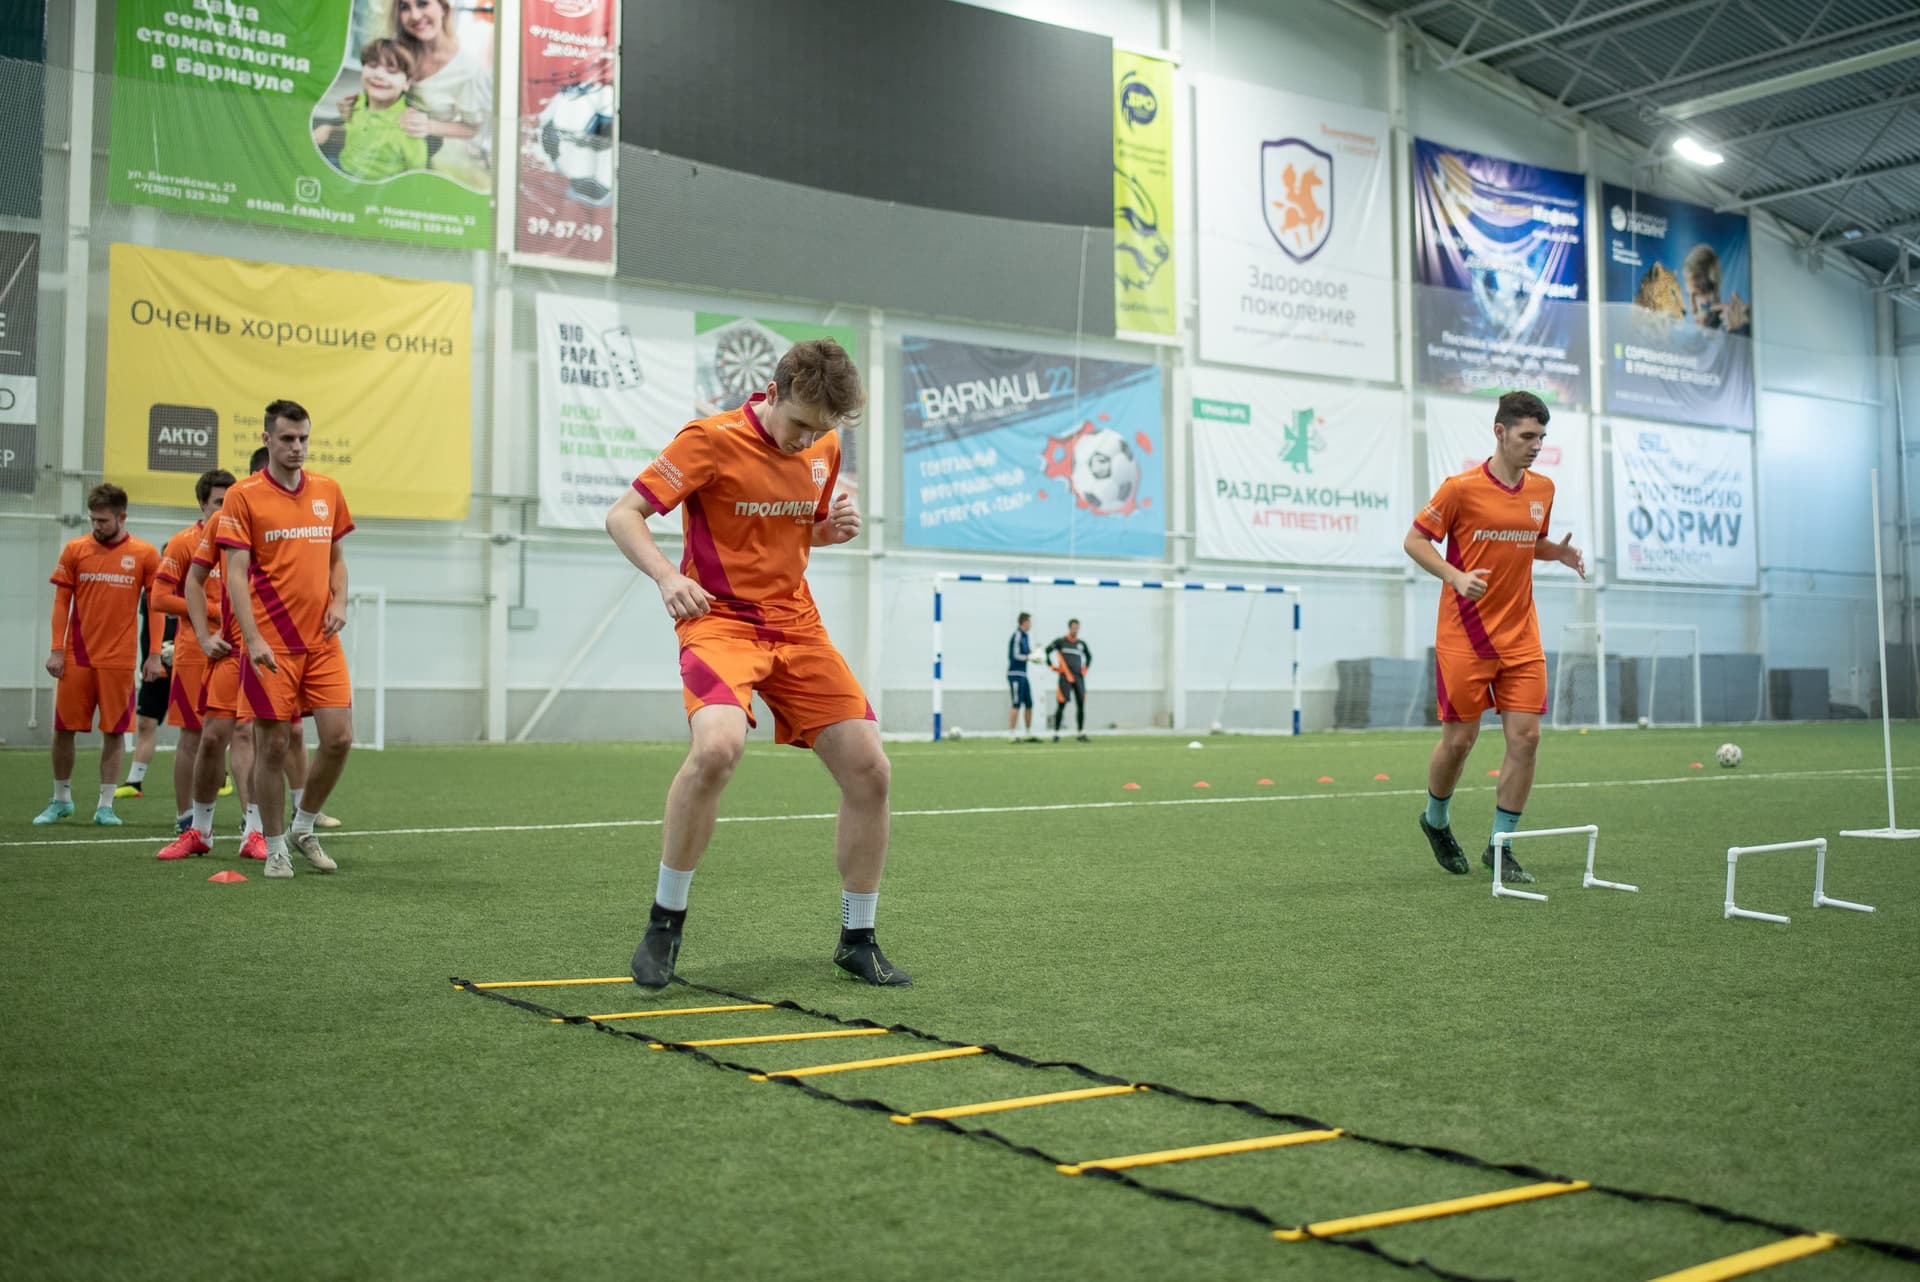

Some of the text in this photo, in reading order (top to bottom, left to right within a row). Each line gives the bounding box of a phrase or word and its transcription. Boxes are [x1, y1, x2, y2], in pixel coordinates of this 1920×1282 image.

[164, 11, 287, 48] семейная
[136, 27, 311, 73] стоматология
[151, 54, 294, 93] в Барнауле
[1247, 264, 1350, 301] Здоровое
[131, 299, 454, 356] Очень хорошие окна
[1240, 294, 1357, 329] поколение
[560, 323, 584, 343] BIG
[560, 346, 598, 366] PAPA
[560, 366, 611, 389] GAMES
[1215, 478, 1389, 510] РАЗДРАКОНИМ
[265, 526, 334, 543] ПРОДИНВЕСТ
[1252, 508, 1360, 533] АППЕТИТ!
[1628, 505, 1743, 548] ФОРМУ
[79, 572, 136, 584] ПРОДИНВЕСТ
